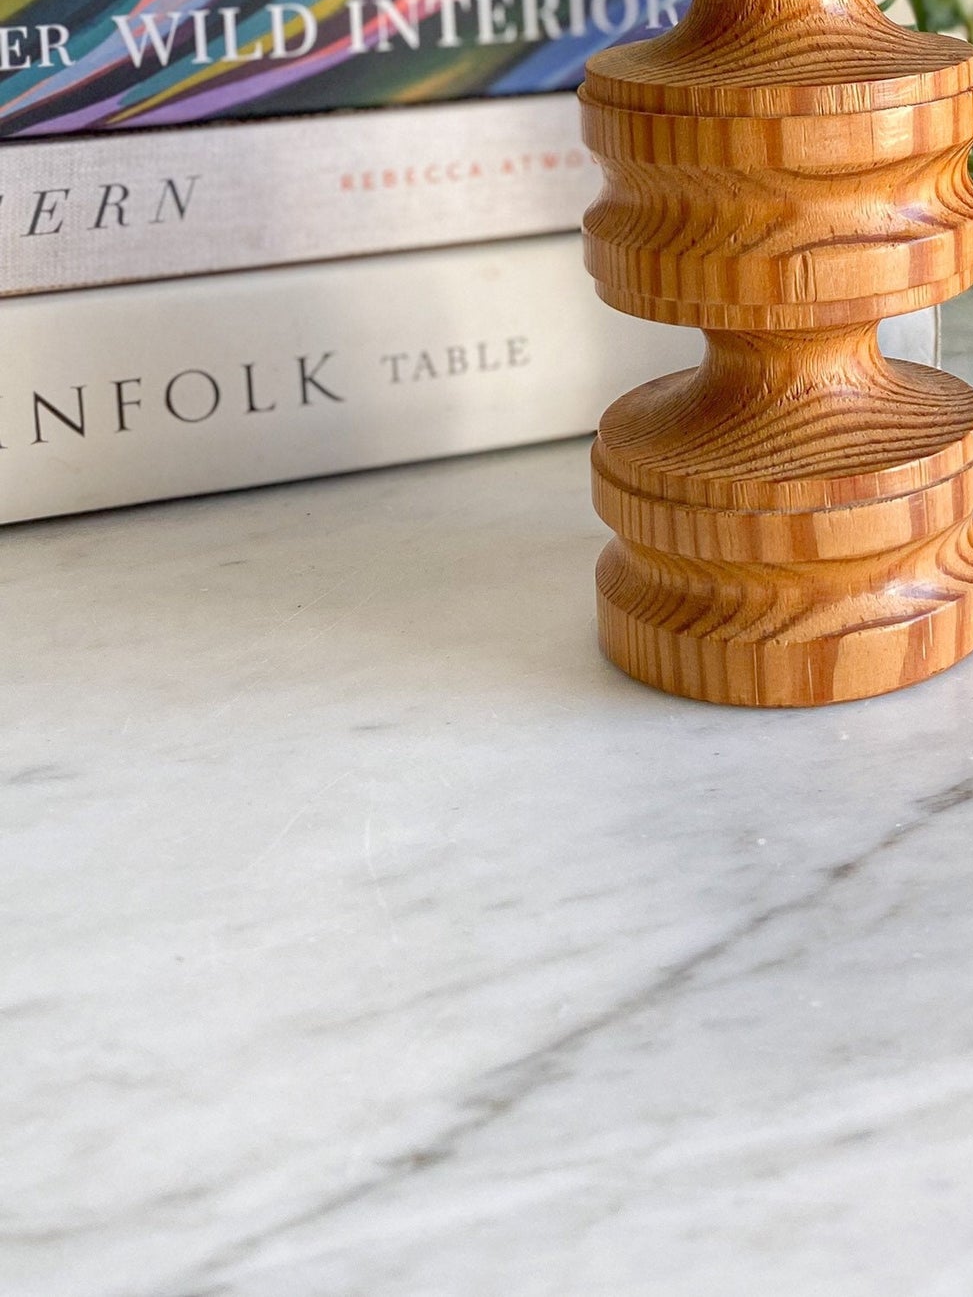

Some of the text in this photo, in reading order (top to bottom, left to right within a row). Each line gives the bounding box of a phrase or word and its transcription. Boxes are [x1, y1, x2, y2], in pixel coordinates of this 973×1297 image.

[0, 24, 76, 70] ER
[111, 1, 318, 69] WILD
[340, 149, 599, 191] REBECCA ATWO
[0, 175, 201, 238] ERN
[381, 336, 531, 385] TABLE
